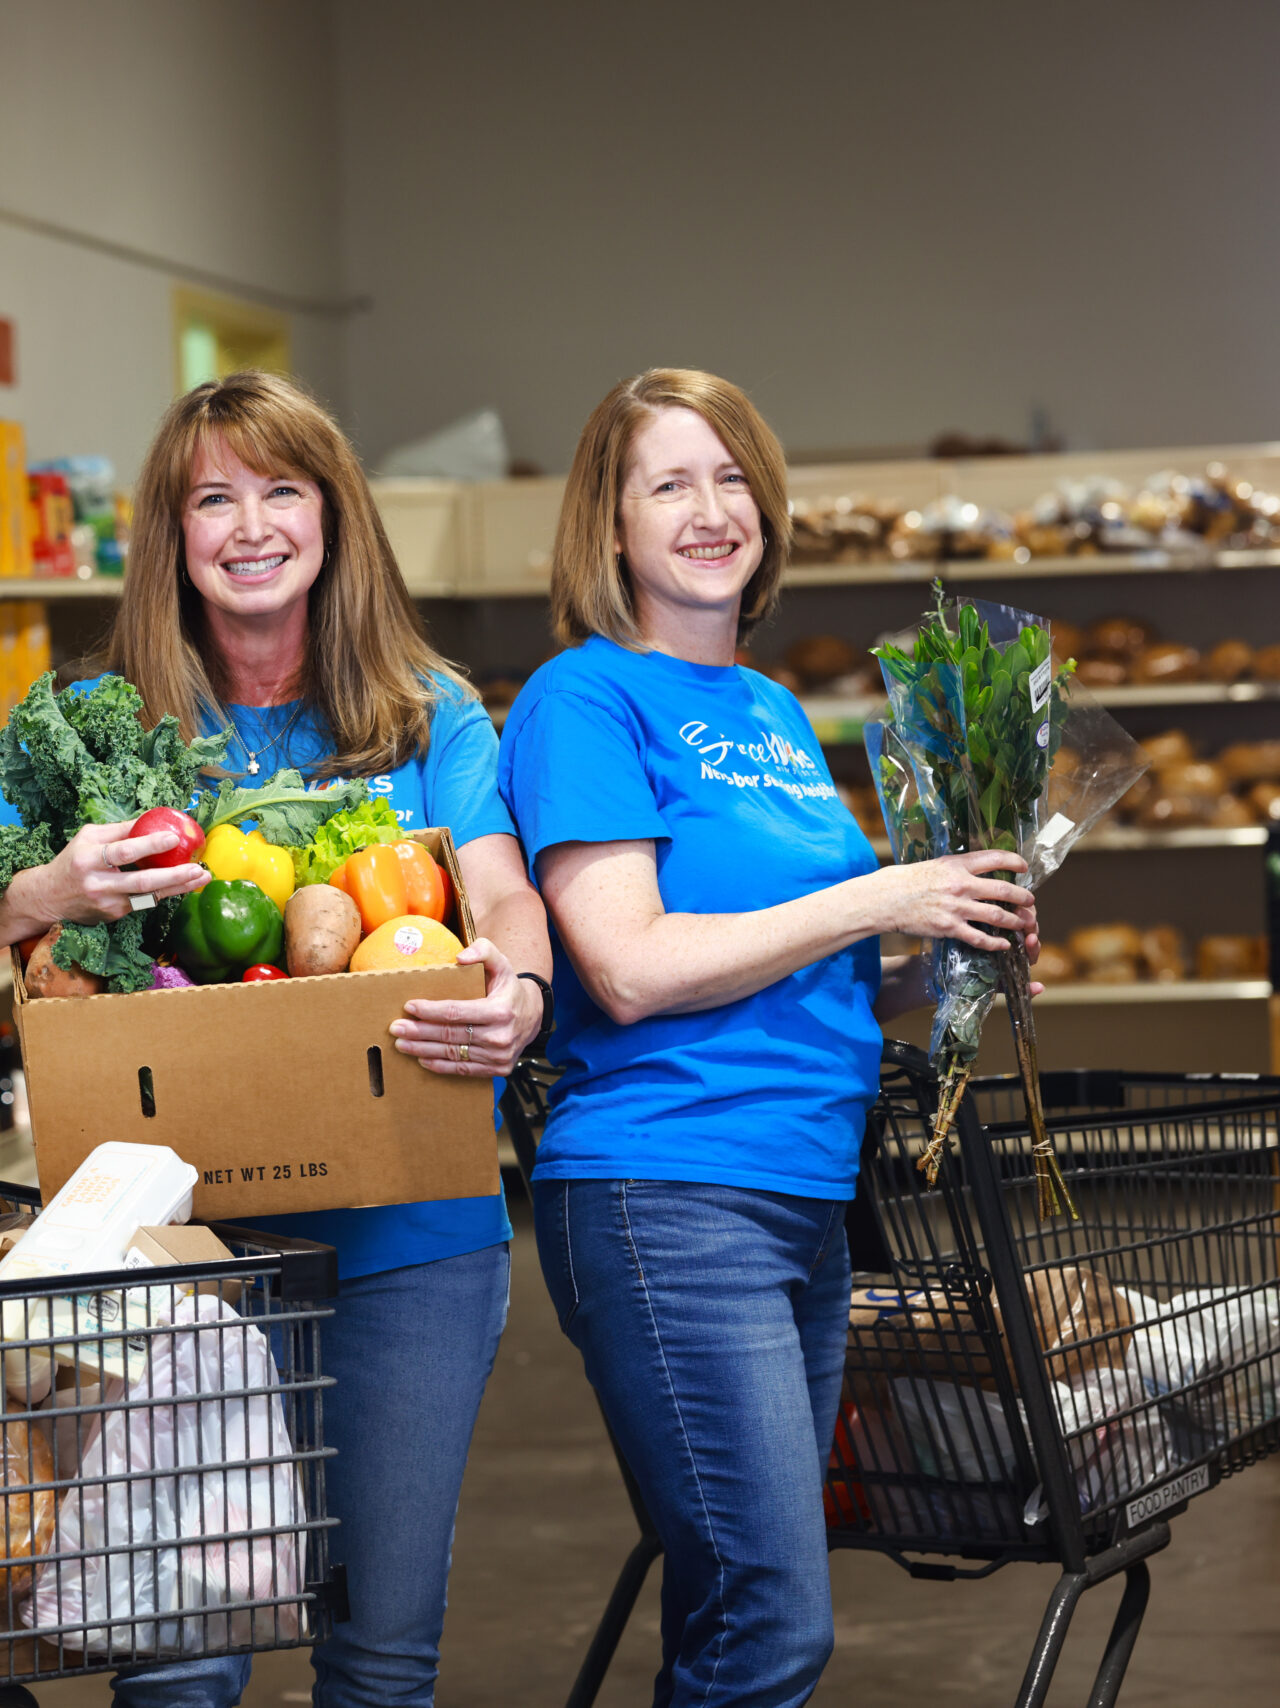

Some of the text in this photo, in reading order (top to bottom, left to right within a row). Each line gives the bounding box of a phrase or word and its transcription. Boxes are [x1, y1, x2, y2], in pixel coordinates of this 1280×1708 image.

[203, 1162, 328, 1185] NET WT 25 LBS
[1129, 1467, 1206, 1523] FOOD PANTRY
